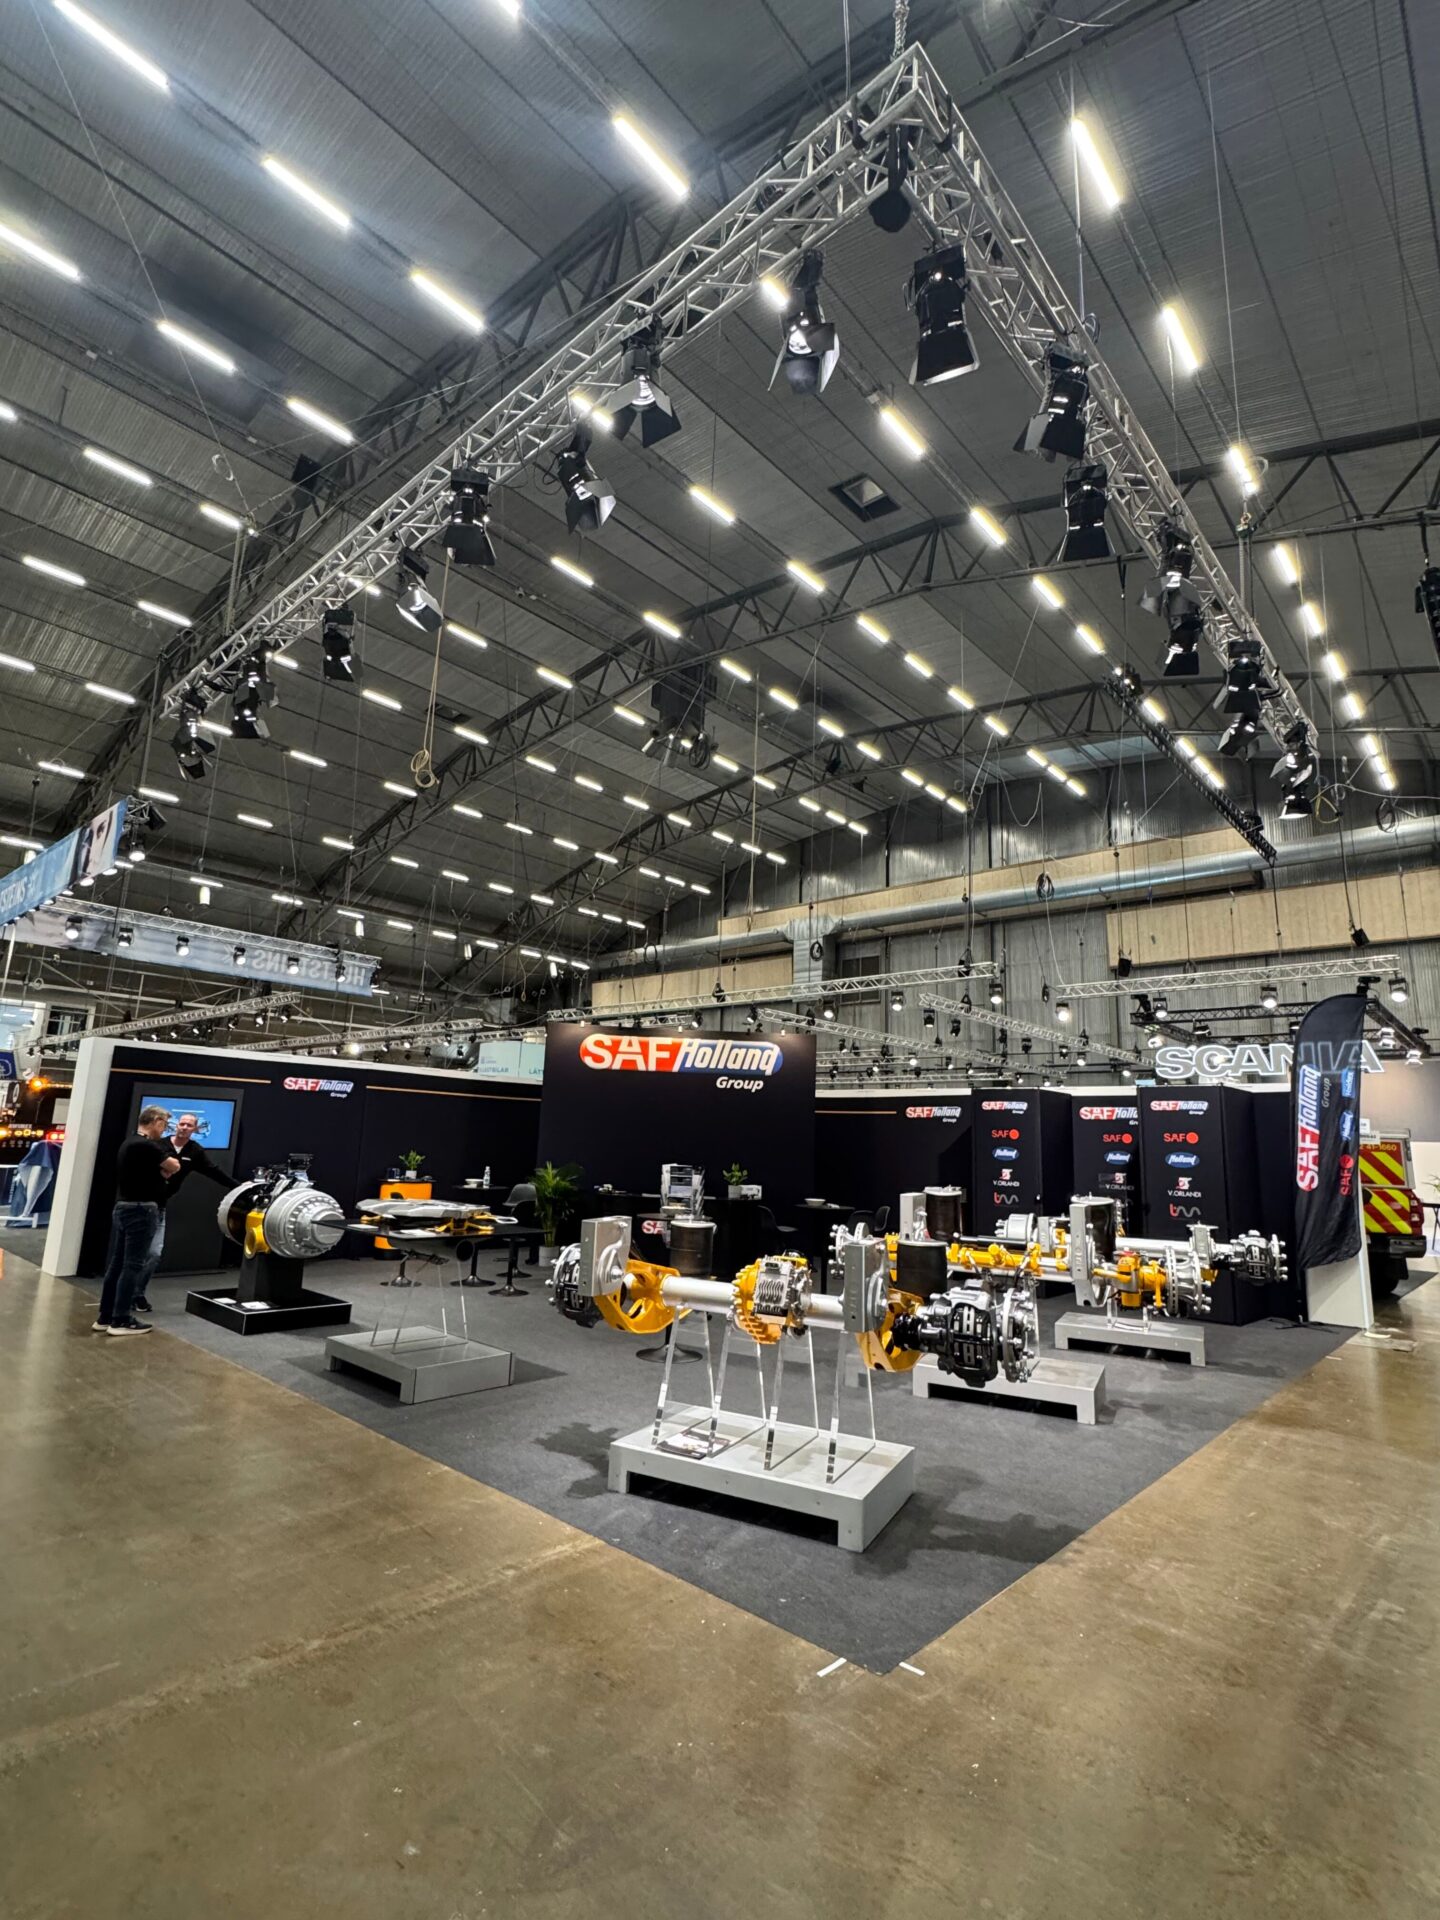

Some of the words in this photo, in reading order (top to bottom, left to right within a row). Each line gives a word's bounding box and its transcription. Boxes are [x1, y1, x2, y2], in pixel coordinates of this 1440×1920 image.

[584, 1034, 673, 1072] SAF
[682, 1038, 780, 1077] Holland
[283, 1077, 317, 1091] SAF
[320, 1079, 354, 1093] Holland
[716, 1076, 764, 1093] Group
[1299, 1064, 1321, 1128] Holland
[1321, 1078, 1332, 1108] Group
[906, 1107, 931, 1118] SAF
[932, 1106, 961, 1118] Holland
[981, 1101, 1003, 1110] SAF
[1149, 1101, 1177, 1110] SAF
[1179, 1101, 1208, 1111] Holland
[1079, 1106, 1113, 1120] SAF
[991, 1129, 1009, 1138] SAF
[1103, 1134, 1121, 1142] SAF
[1163, 1133, 1186, 1142] SAF
[1168, 1155, 1196, 1165] Holland
[1297, 1133, 1319, 1191] SAF
[1340, 1169, 1353, 1196] SAF
[641, 1220, 667, 1234] SA
